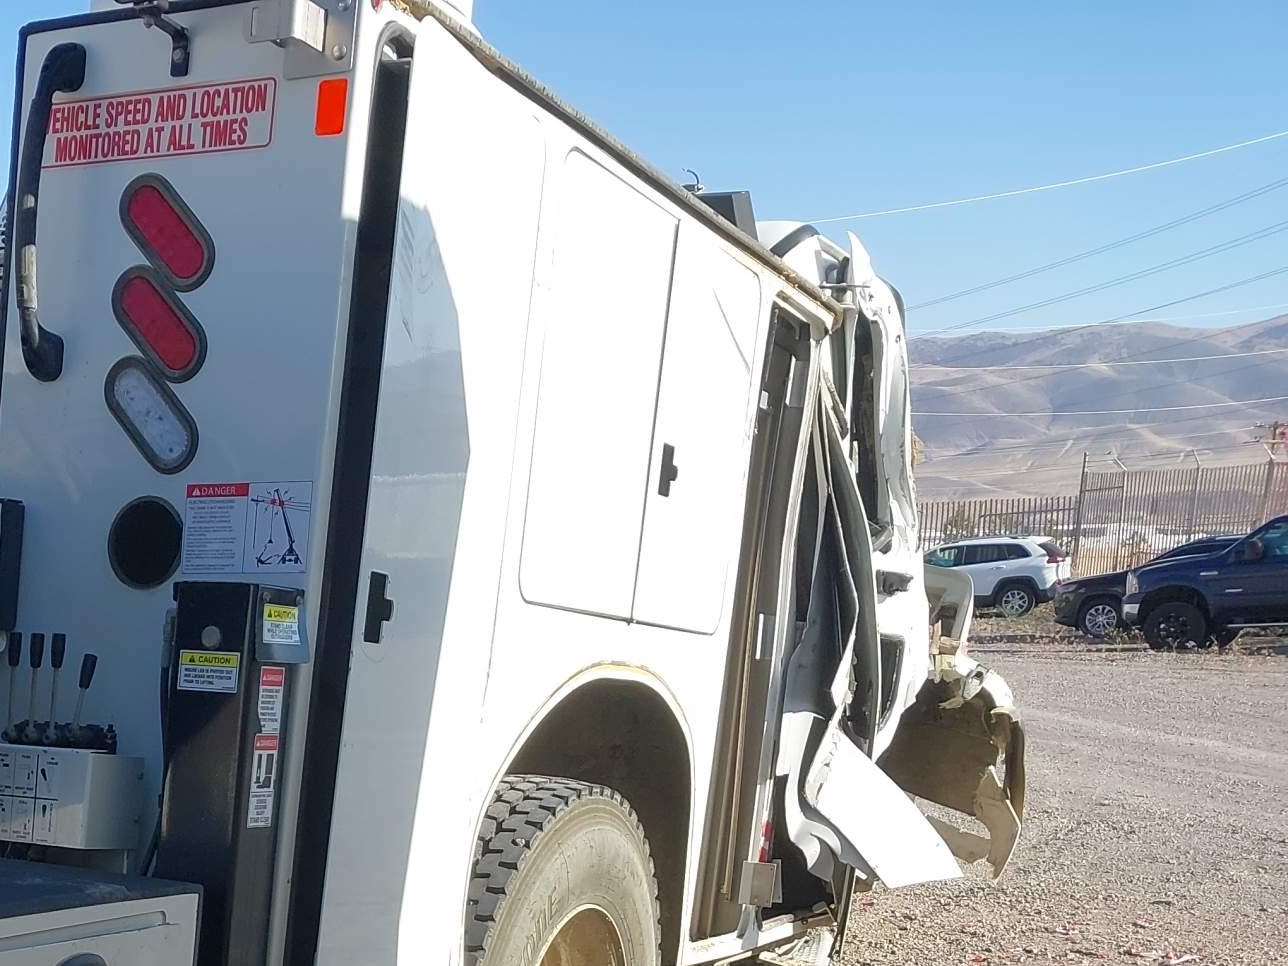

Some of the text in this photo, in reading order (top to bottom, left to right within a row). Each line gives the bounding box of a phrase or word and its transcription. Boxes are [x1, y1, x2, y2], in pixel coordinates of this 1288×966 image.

[105, 98, 151, 128] SPEED
[155, 93, 187, 123] AND
[191, 83, 268, 119] LOCATION
[55, 117, 248, 162] MONITORED AT ALL TIMES
[201, 486, 236, 496] DANGER
[198, 655, 231, 665] CAUTION
